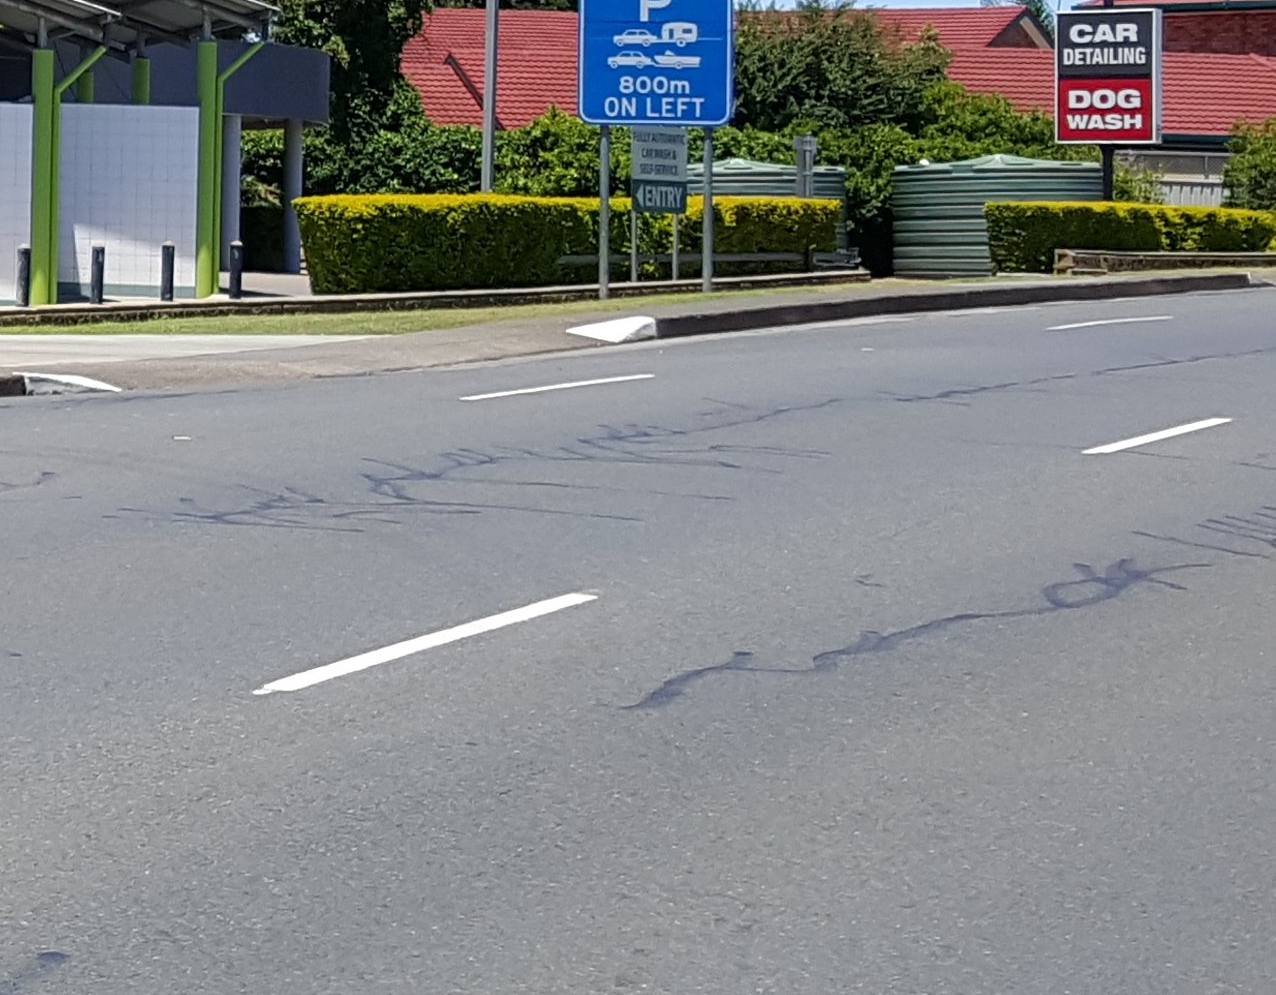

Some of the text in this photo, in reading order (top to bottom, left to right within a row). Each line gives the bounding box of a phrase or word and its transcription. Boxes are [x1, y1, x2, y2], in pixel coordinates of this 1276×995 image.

[1069, 23, 1138, 44] CAR
[1063, 47, 1147, 65] DETAILING
[619, 76, 690, 94] 800m
[604, 97, 705, 117] ON LEFT
[1068, 89, 1141, 109] DOG
[1067, 114, 1143, 130] WASH
[645, 185, 683, 208] ENTRY
